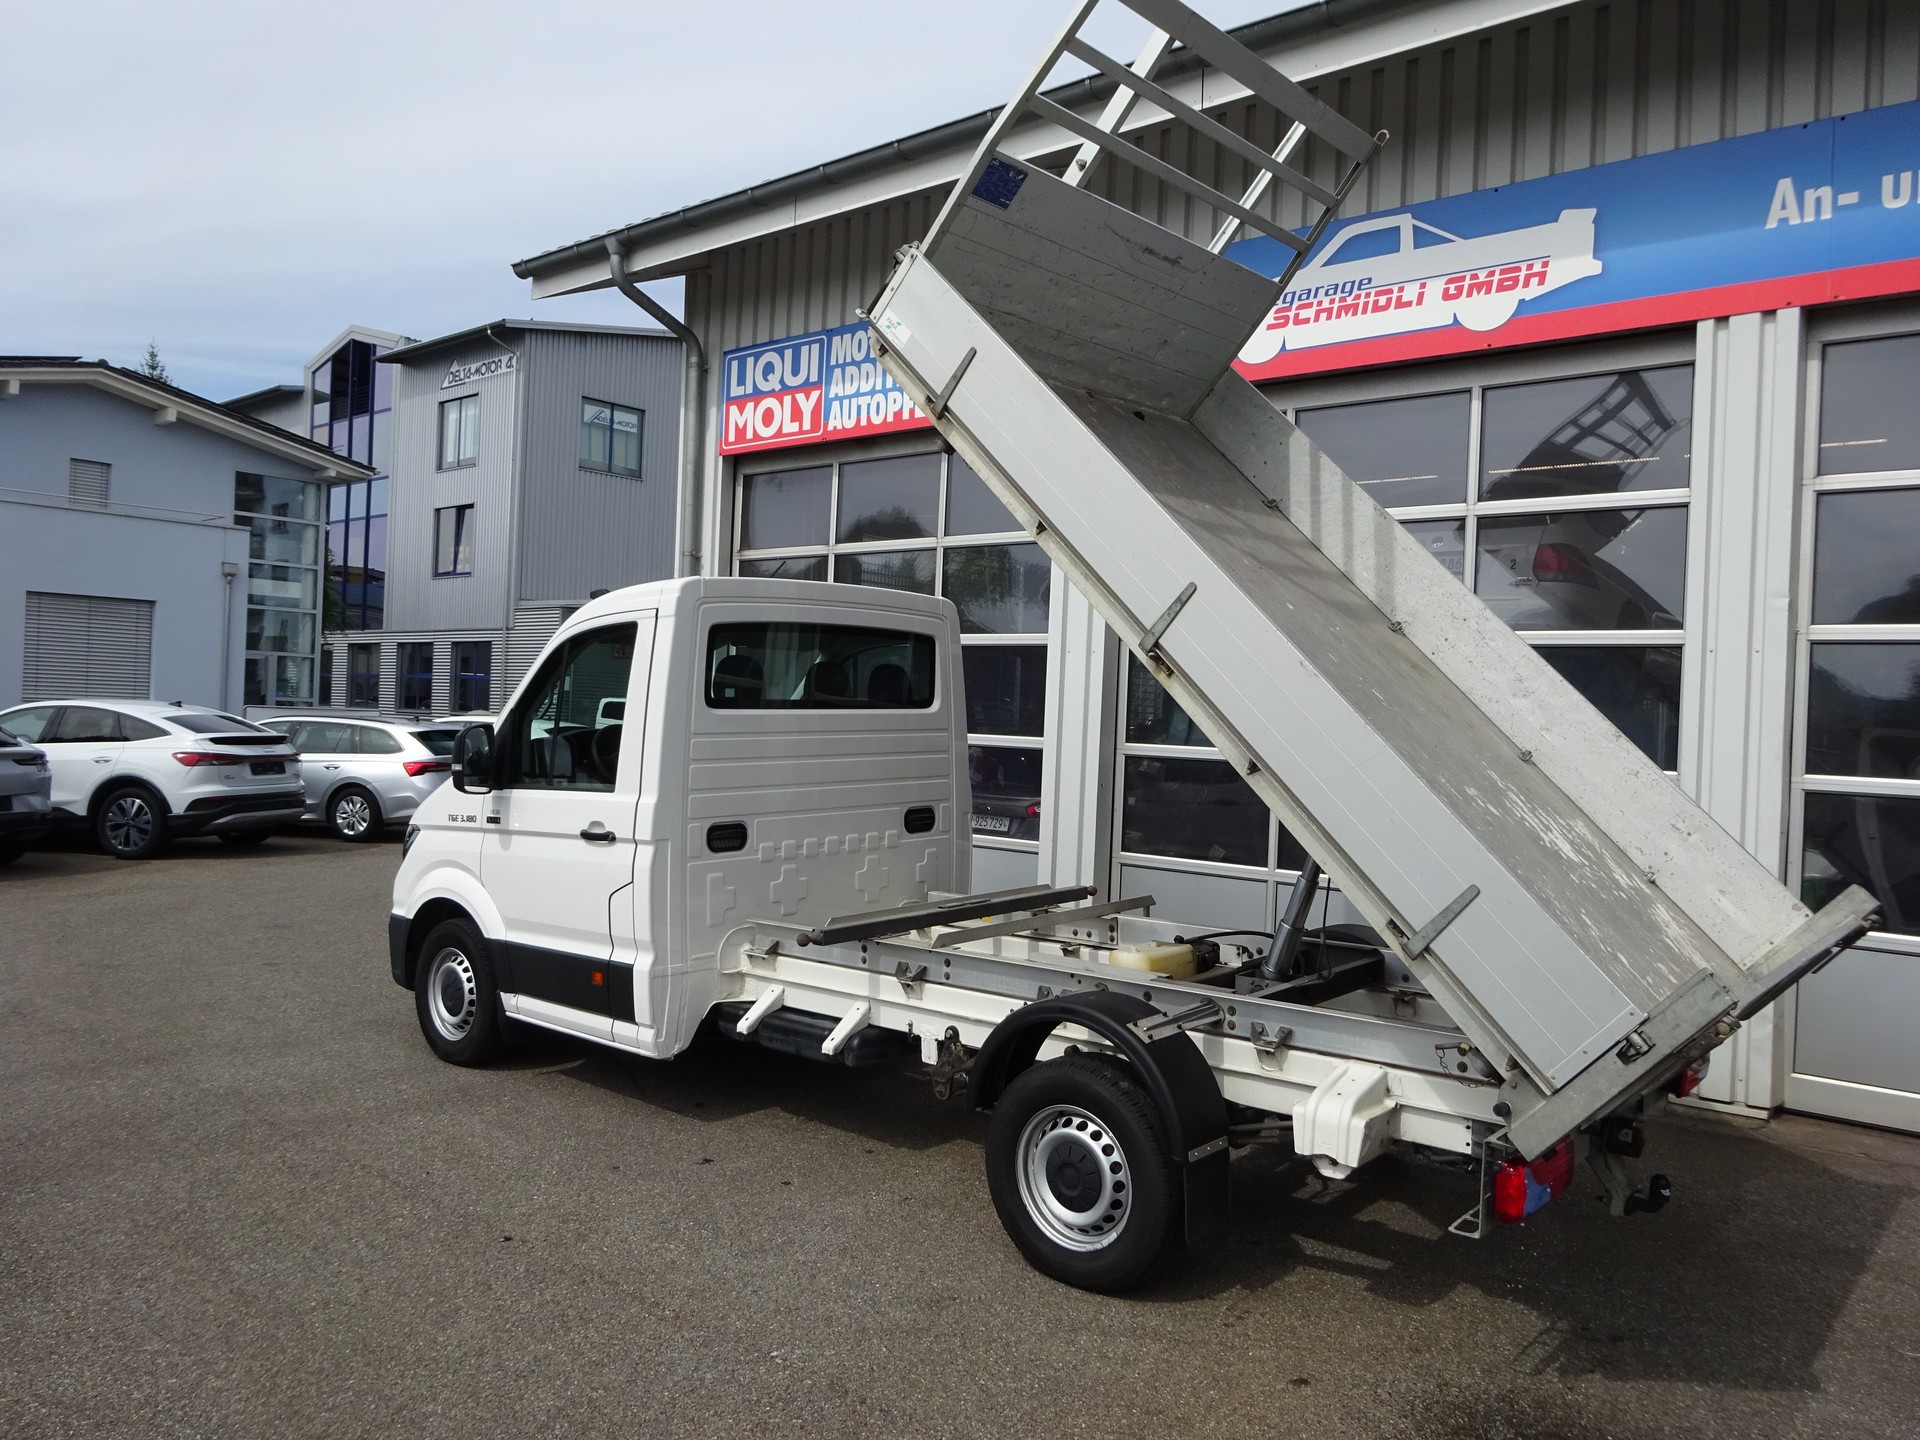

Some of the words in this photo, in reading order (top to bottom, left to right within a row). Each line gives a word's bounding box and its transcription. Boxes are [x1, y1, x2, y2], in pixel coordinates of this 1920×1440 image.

[1764, 176, 1860, 230] An-
[1881, 169, 1920, 209] u
[1265, 282, 1427, 332] SCHMIDLI
[1441, 260, 1551, 302] GMBH
[1281, 276, 1373, 309] garage
[729, 343, 820, 398] LIQUI
[727, 389, 822, 443] MOLY
